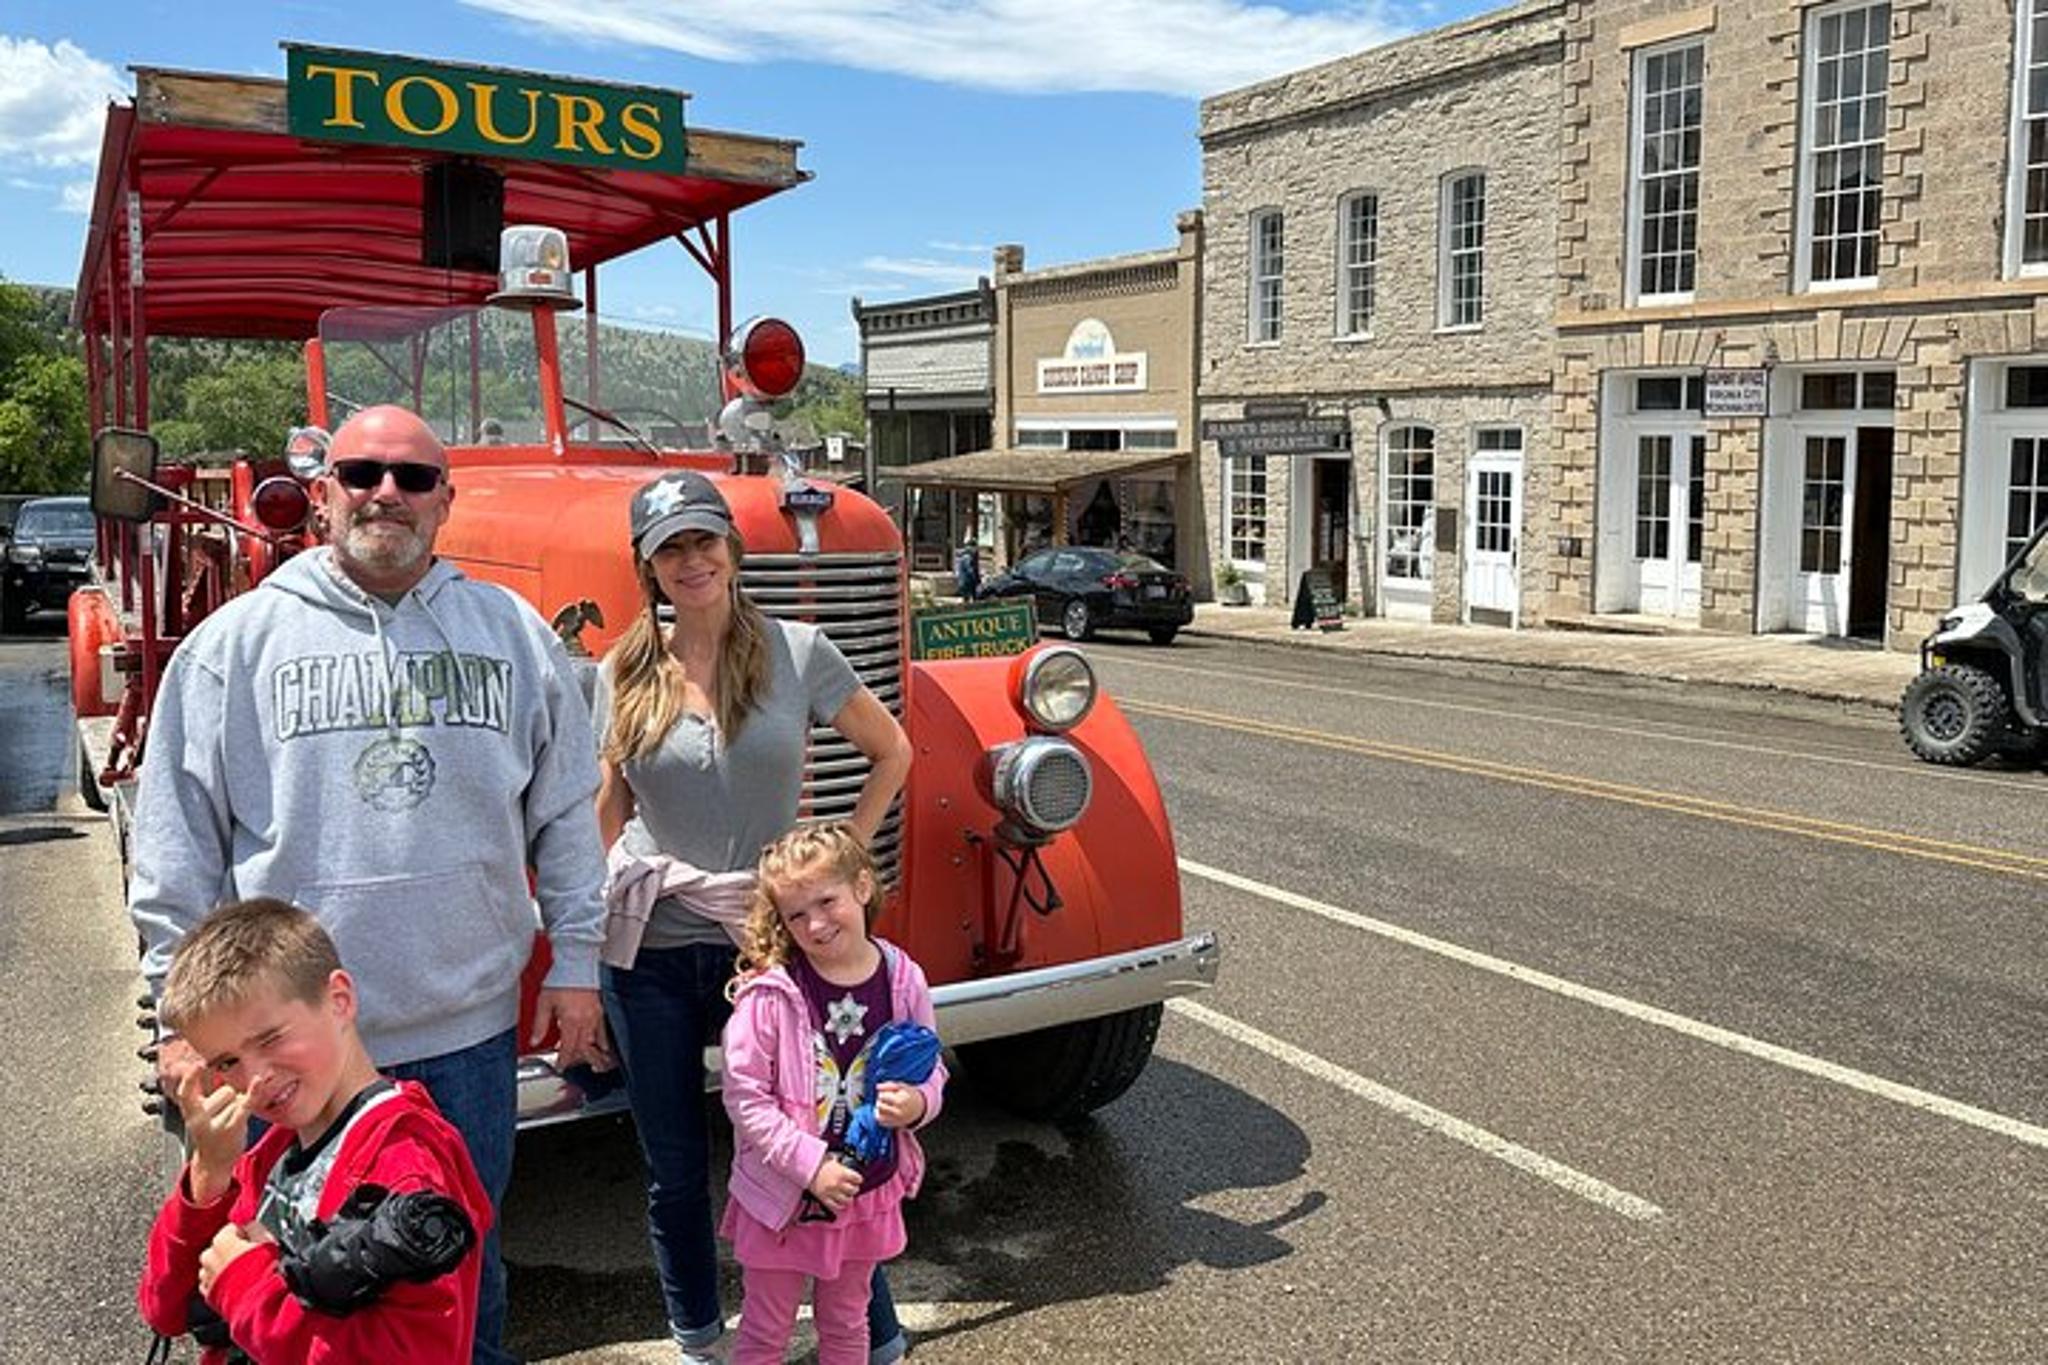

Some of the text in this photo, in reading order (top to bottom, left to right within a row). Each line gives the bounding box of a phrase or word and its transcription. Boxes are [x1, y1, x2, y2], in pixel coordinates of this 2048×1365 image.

[306, 64, 663, 160] TOURS
[930, 614, 1022, 638] ANTIQUE
[972, 636, 1030, 656] TRUCK
